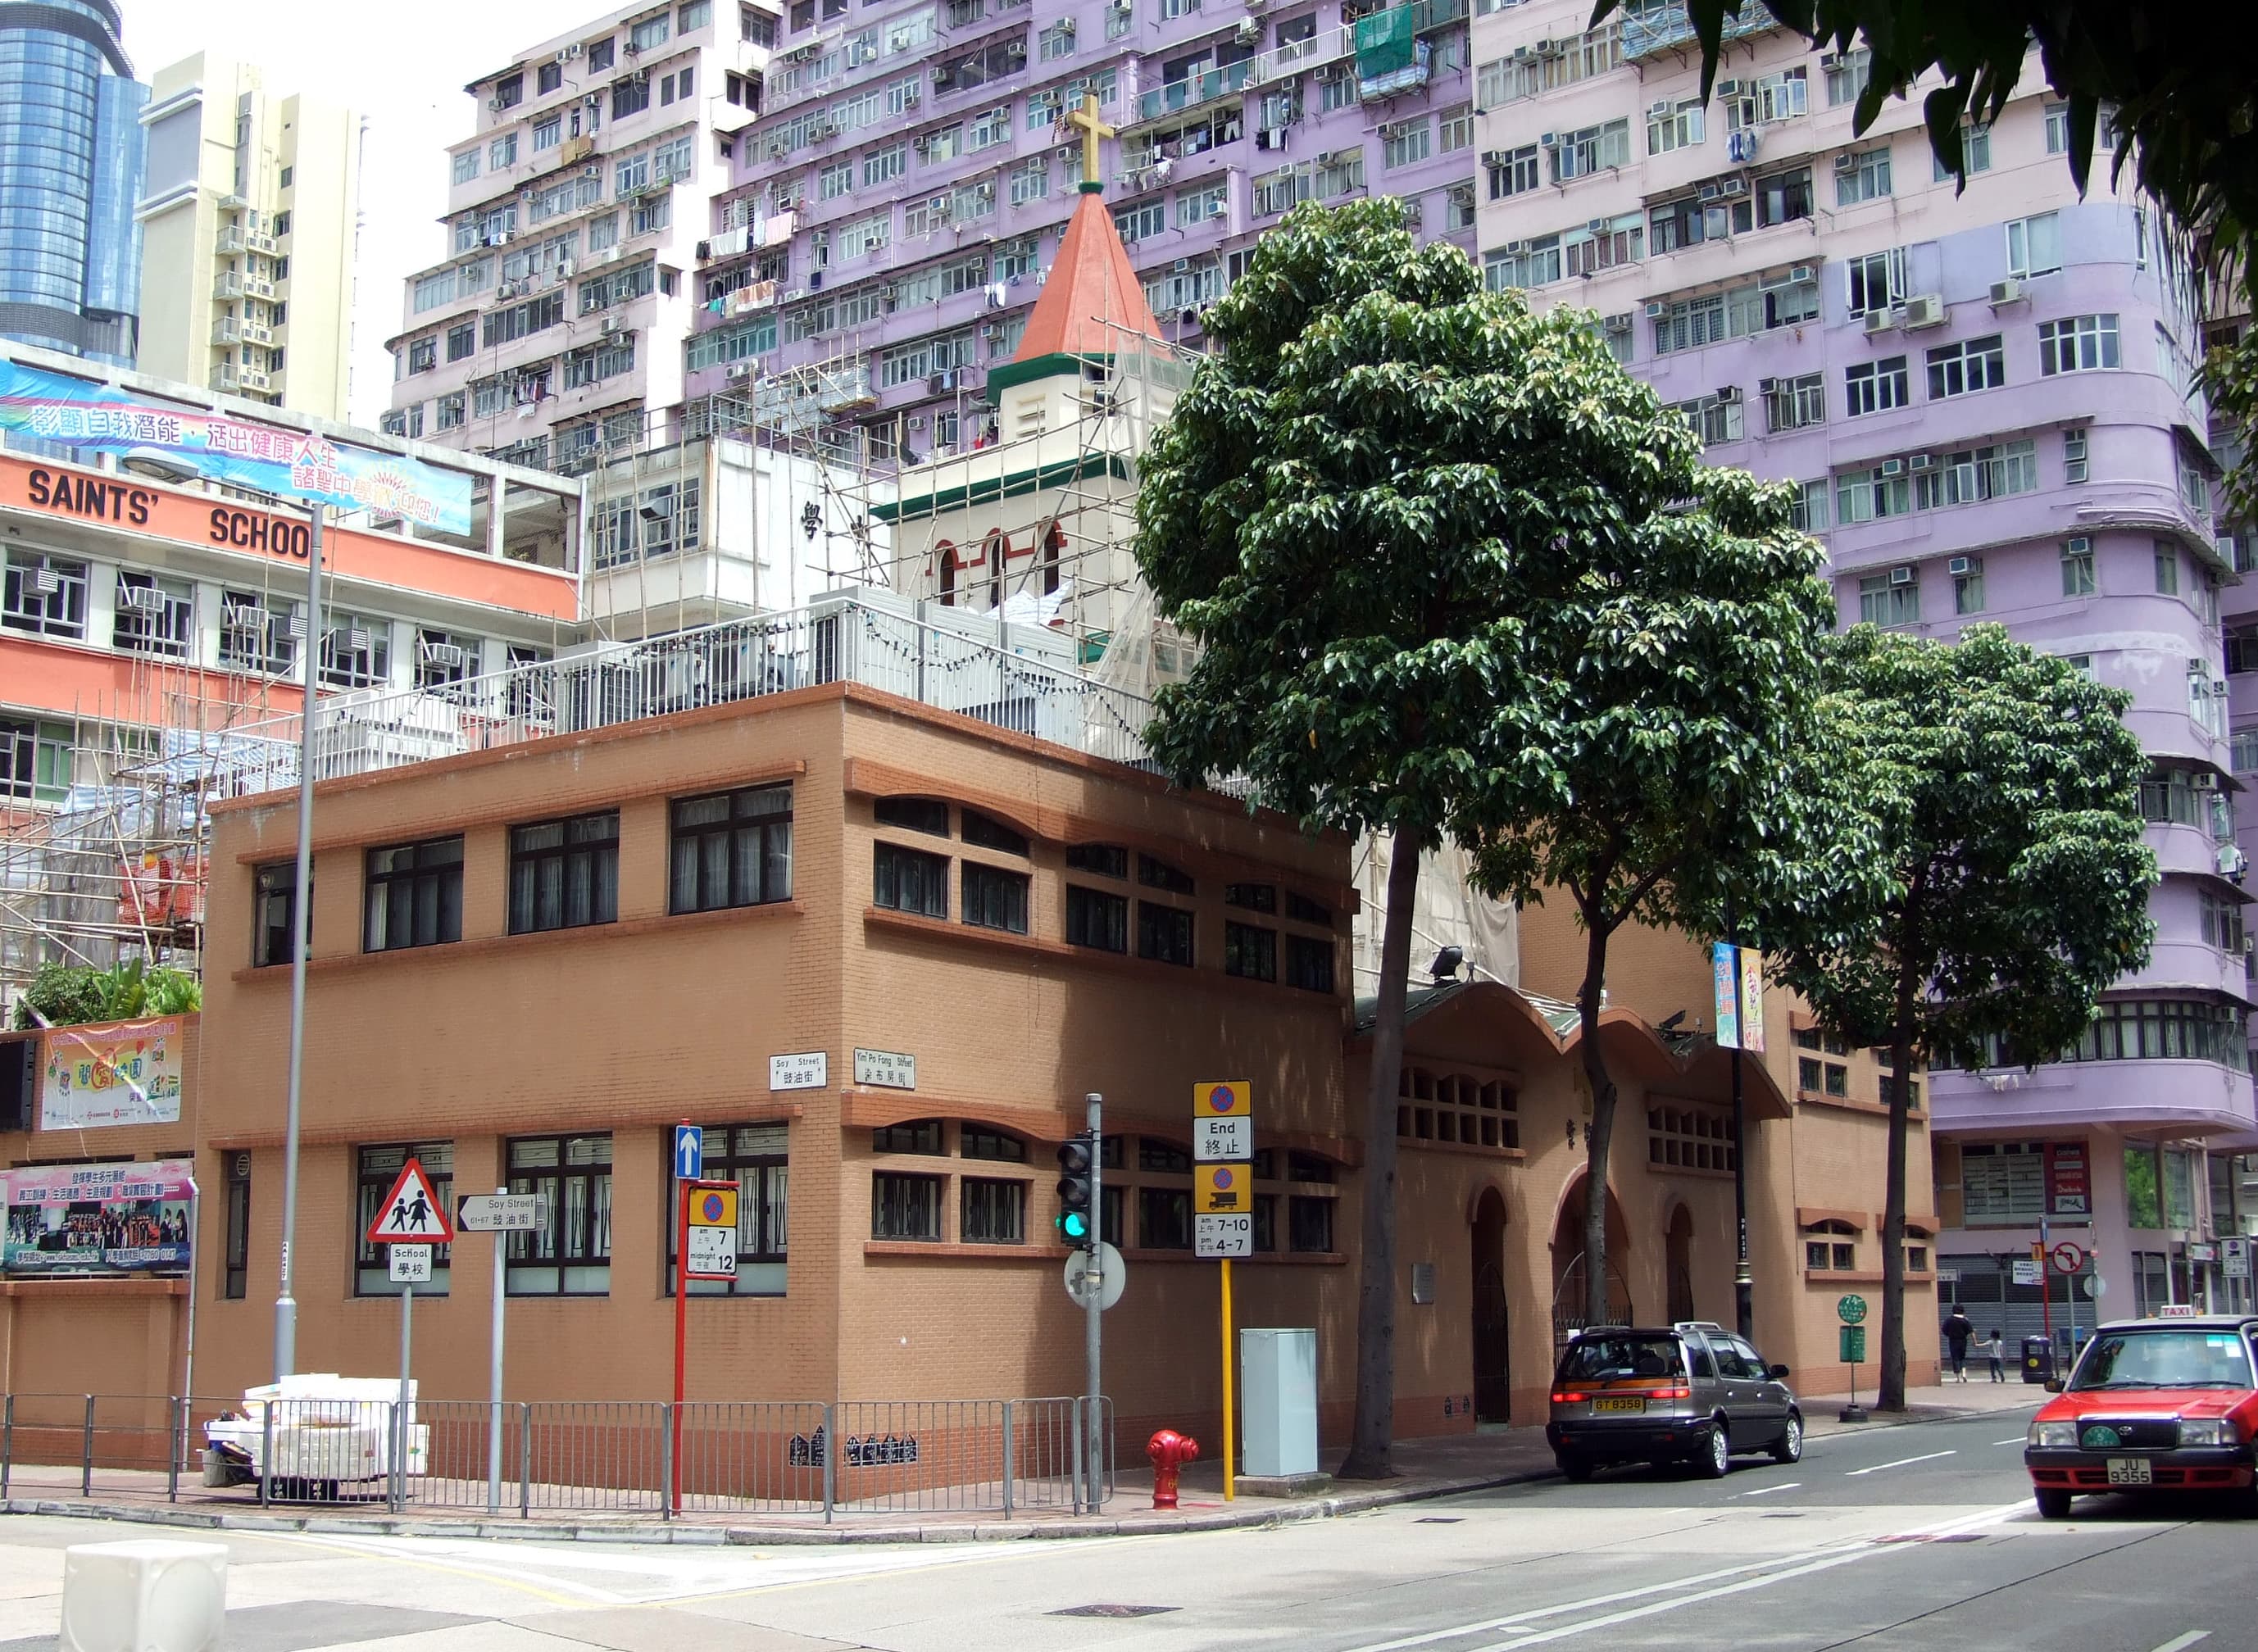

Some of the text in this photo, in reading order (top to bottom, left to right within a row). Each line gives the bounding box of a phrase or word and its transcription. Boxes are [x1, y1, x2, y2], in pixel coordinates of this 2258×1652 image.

[801, 501, 823, 540] 學
[210, 508, 326, 563] SCHOO
[776, 1058, 820, 1068] Soy Street
[856, 1052, 866, 1062] Yim
[869, 1053, 876, 1063] Po
[897, 1057, 912, 1068] Street
[1210, 1122, 1235, 1134] End
[1205, 1138, 1240, 1155] 終止
[488, 1198, 534, 1210] Soy Street
[1218, 1219, 1248, 1231] 7-10
[719, 1230, 727, 1245] 7
[394, 1248, 428, 1258] School
[719, 1255, 733, 1270] 12
[398, 1262, 424, 1276] 學校
[2162, 1307, 2189, 1317] TAXI
[1596, 1399, 1642, 1409] GT 8358
[2119, 1459, 2138, 1471] JU
[2110, 1471, 2150, 1482] 9355
